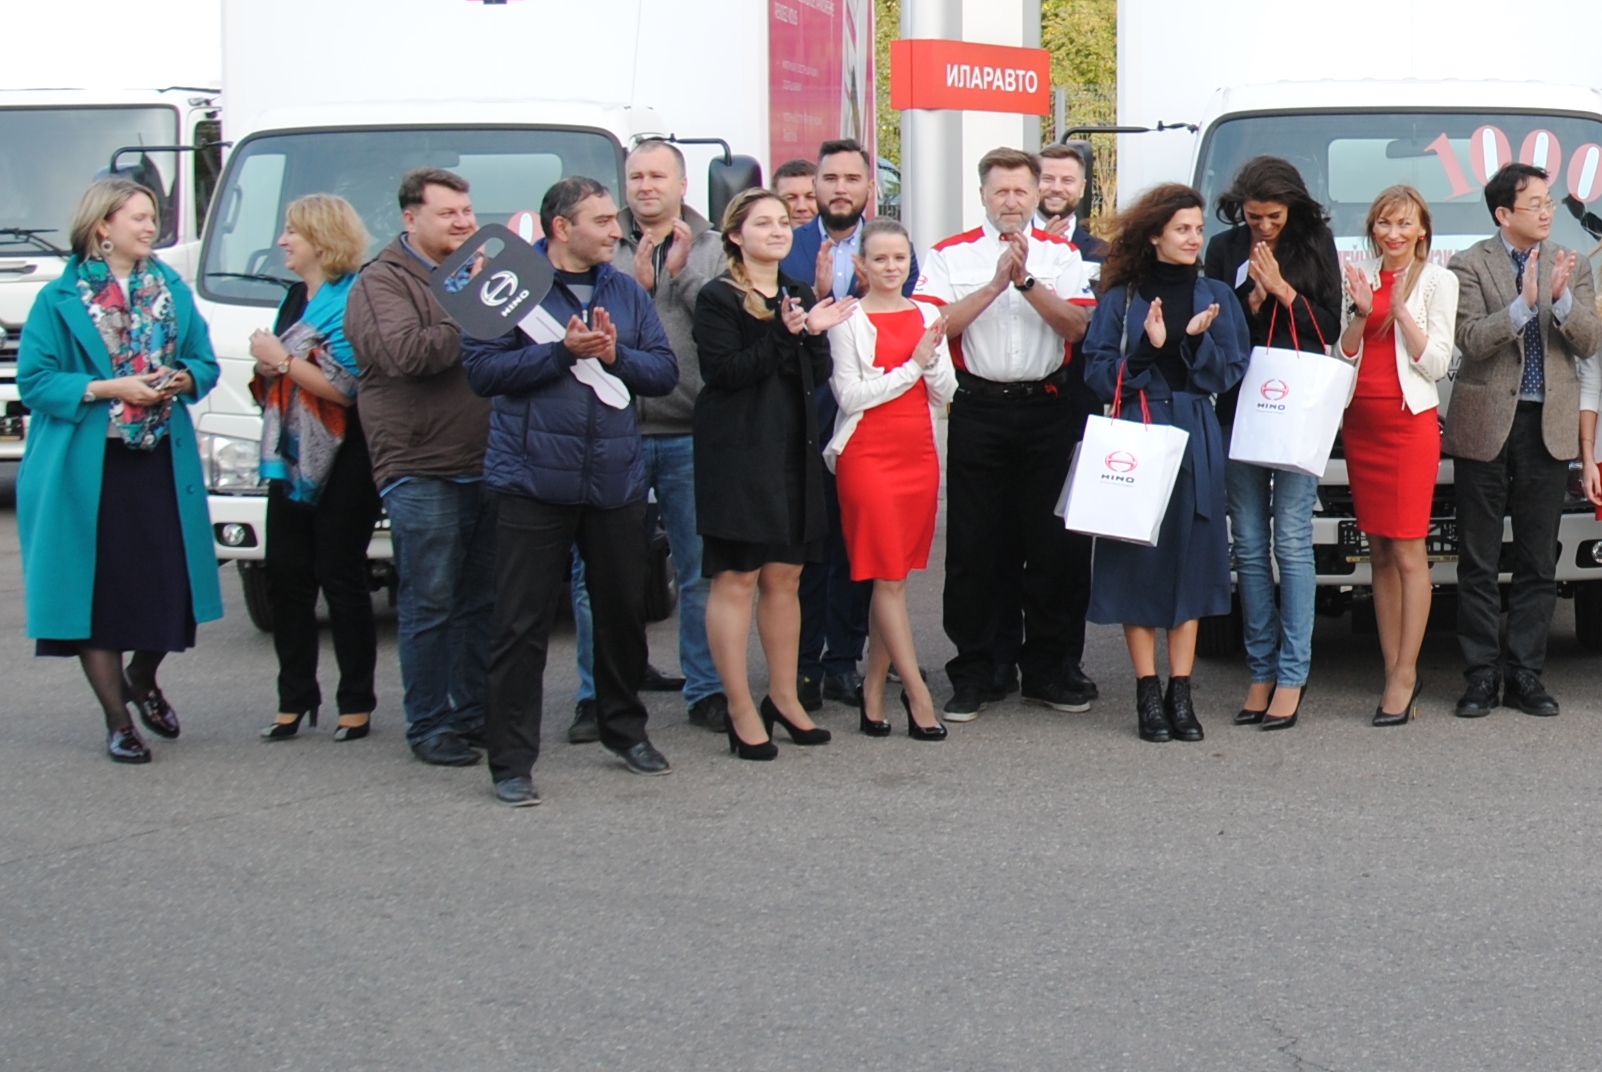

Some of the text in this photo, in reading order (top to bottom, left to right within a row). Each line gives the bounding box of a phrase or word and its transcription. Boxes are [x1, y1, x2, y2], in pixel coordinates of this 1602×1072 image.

[946, 63, 1038, 94] ИЛАРАВТО
[501, 289, 530, 317] HINO
[1257, 402, 1286, 411] HINO
[1101, 473, 1135, 484] HINO
